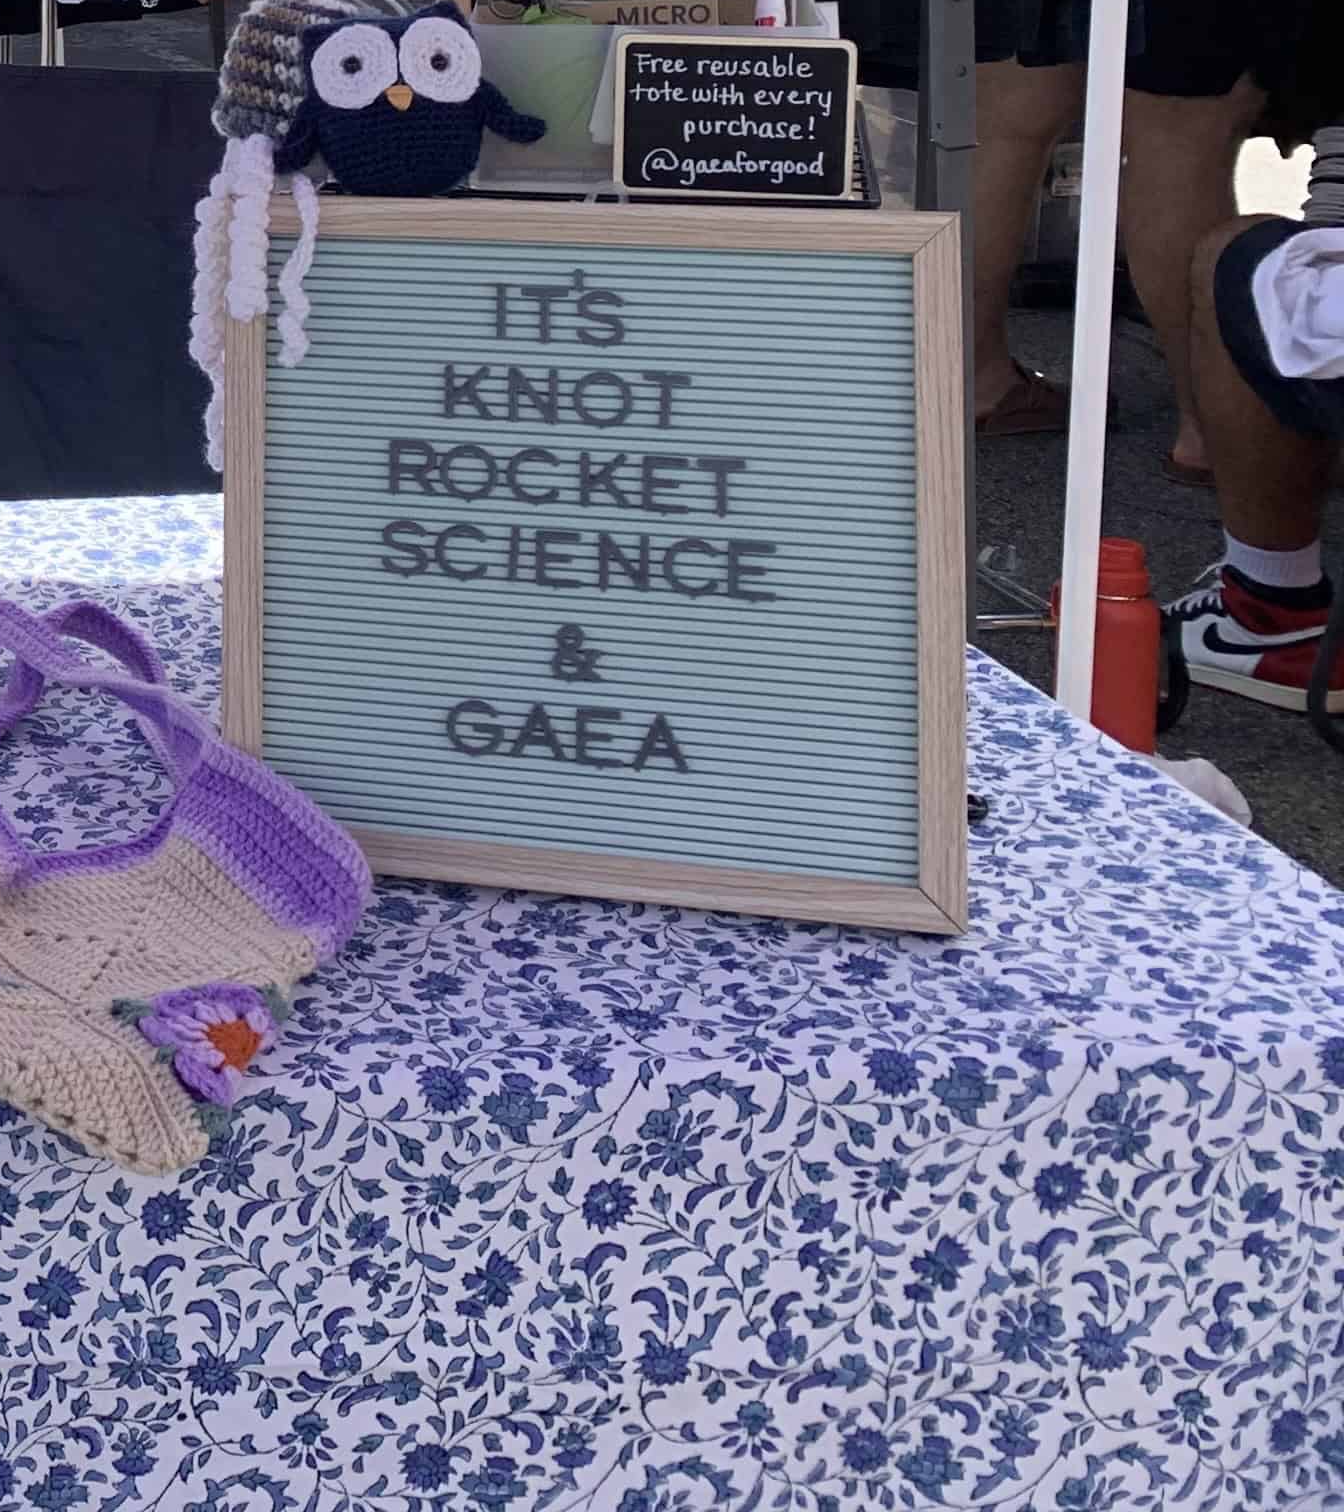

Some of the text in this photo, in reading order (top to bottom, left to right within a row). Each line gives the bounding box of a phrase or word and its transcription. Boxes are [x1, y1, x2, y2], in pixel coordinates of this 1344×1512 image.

[616, 4, 710, 25] MICRO
[633, 52, 814, 78] Free reusable
[629, 81, 833, 117] tote with every
[683, 114, 816, 143] purchase!
[642, 148, 824, 185] @gaeaforgood
[494, 268, 626, 348] IT'S
[442, 362, 693, 430] KNOT
[387, 438, 747, 518] ROCKET
[380, 519, 778, 602] SCIENCE
[551, 622, 607, 682] &
[446, 698, 689, 774] GAEA
